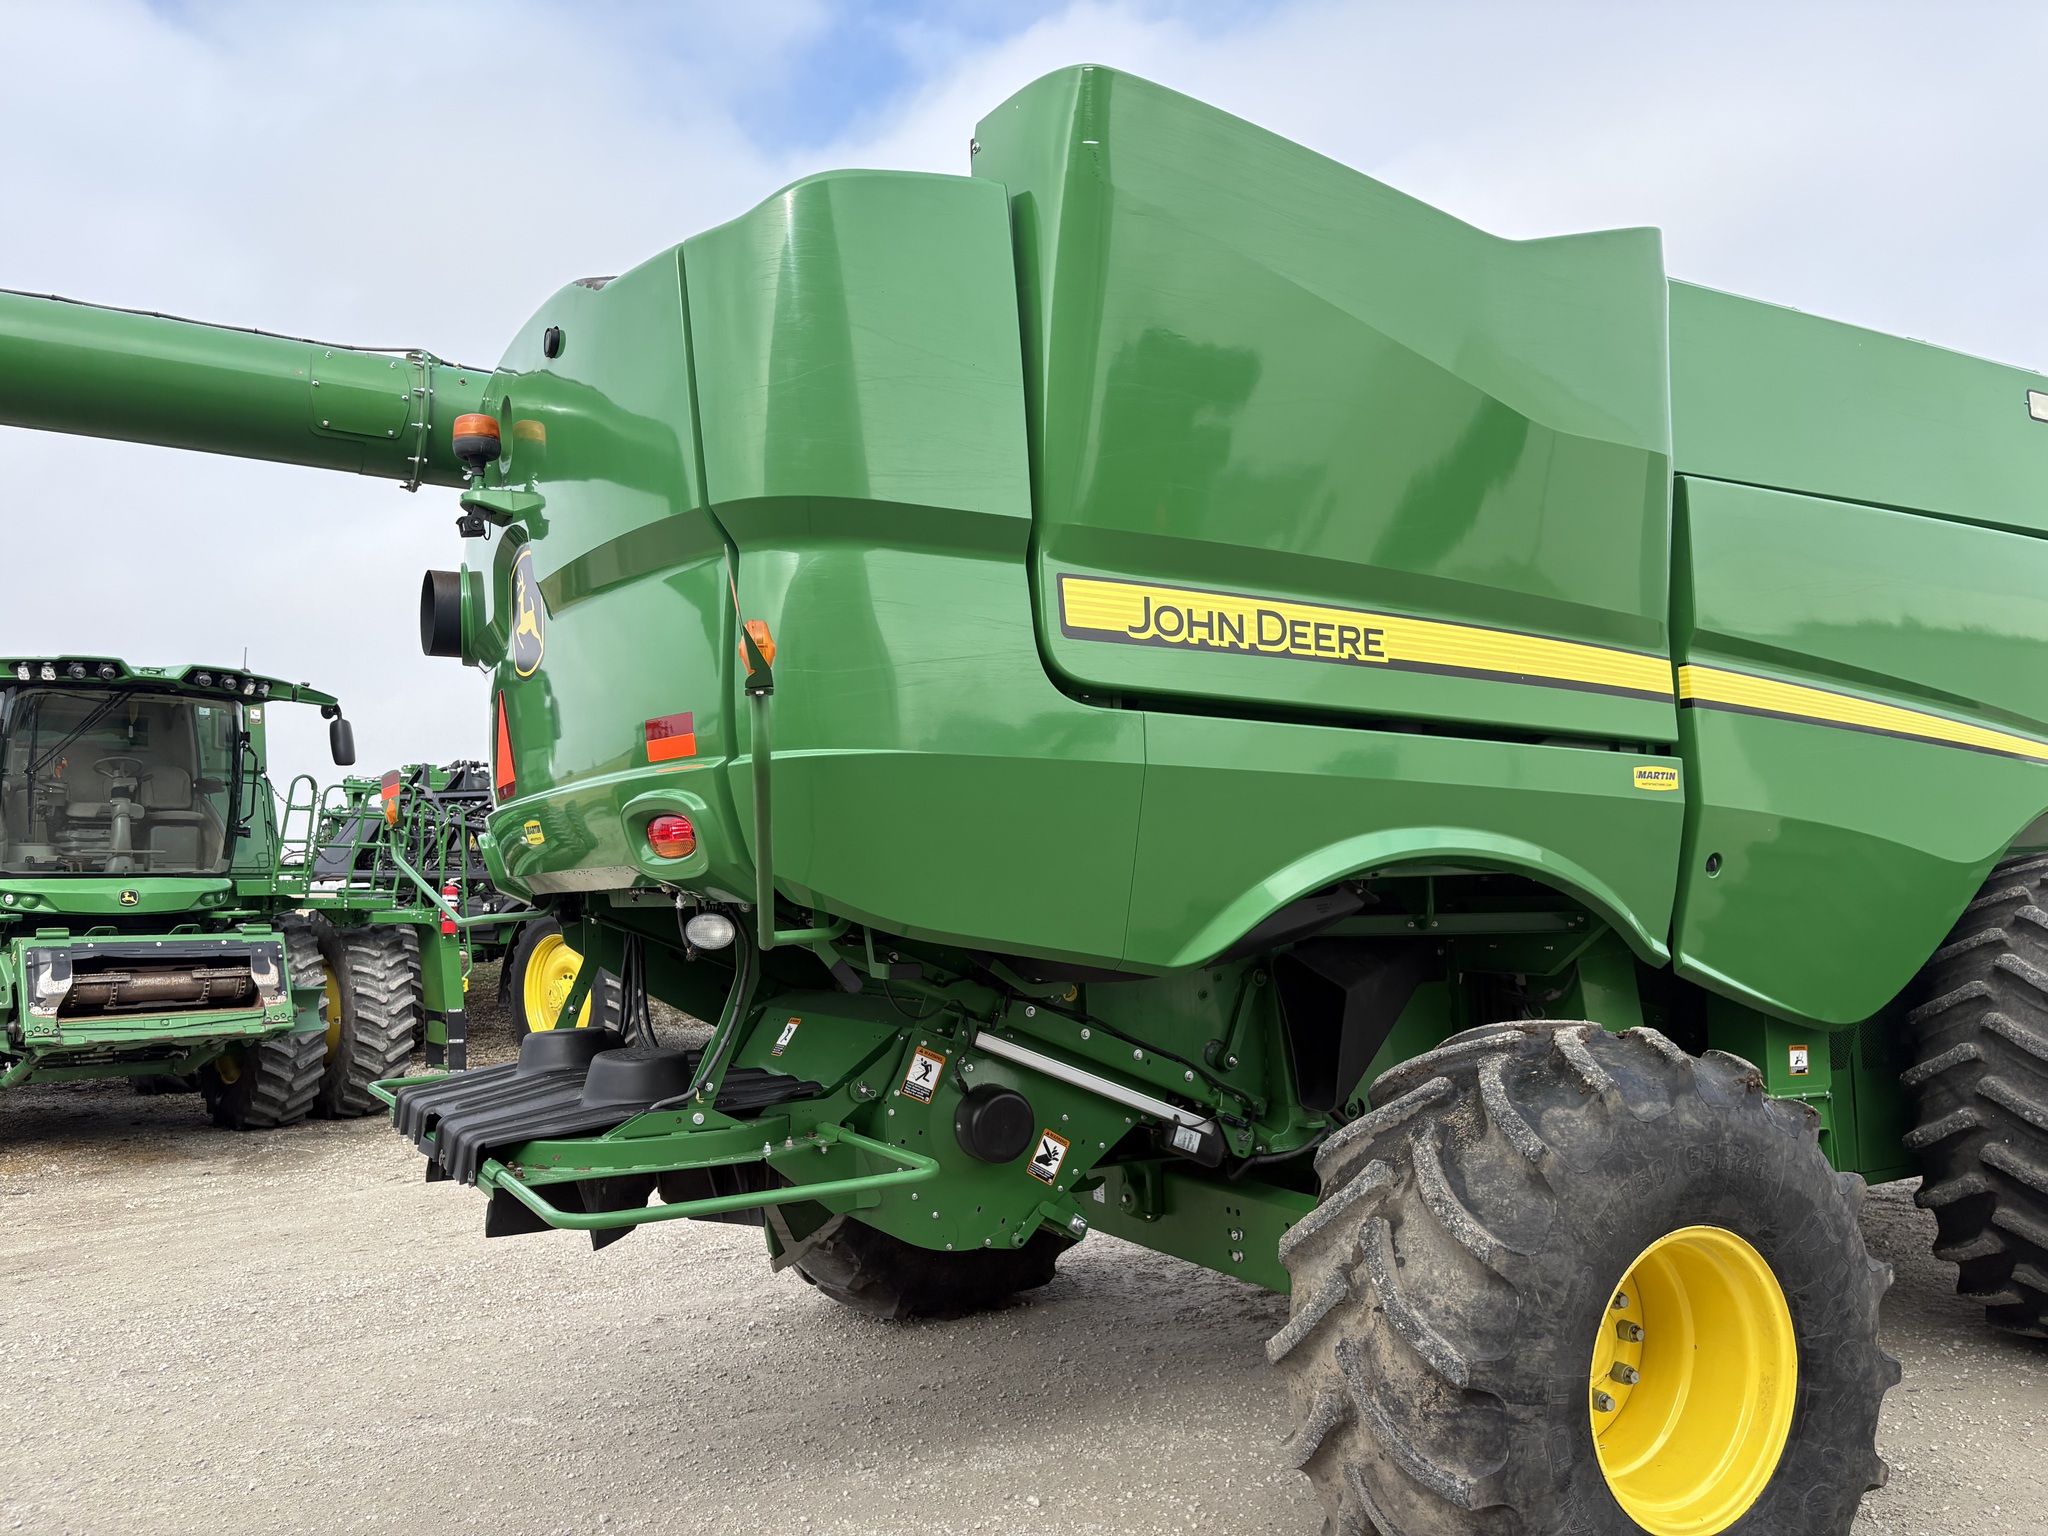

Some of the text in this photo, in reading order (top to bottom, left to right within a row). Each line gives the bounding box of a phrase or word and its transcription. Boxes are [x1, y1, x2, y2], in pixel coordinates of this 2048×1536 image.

[1127, 596, 1386, 659] JOHN DEERE
[1637, 770, 1676, 780] MARTIN
